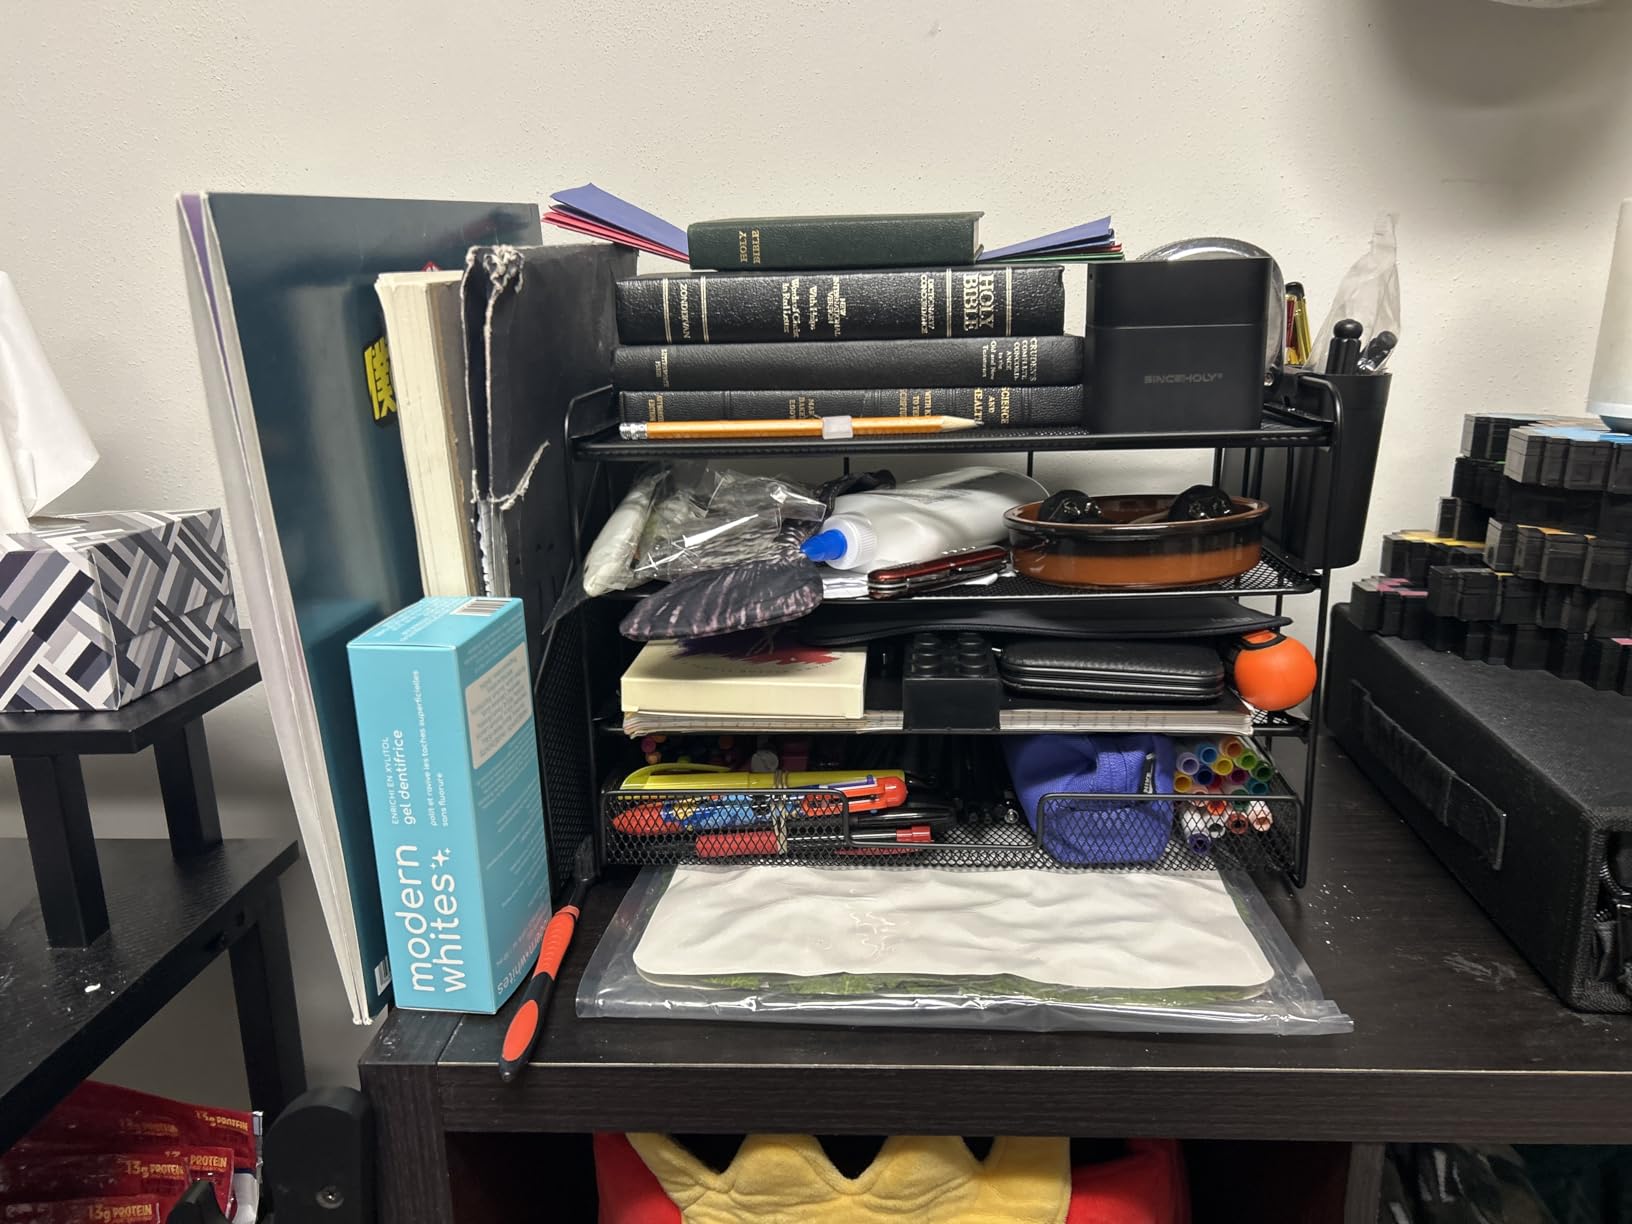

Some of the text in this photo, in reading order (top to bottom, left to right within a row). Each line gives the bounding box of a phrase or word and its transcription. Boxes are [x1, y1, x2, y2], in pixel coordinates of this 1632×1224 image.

[738, 231, 748, 263] HOLY
[751, 229, 761, 264] BIBLE
[679, 283, 691, 339] ZONDERVAN
[809, 285, 818, 307] With
[832, 275, 841, 337] INTERNATIONAL
[920, 274, 929, 334] CONCORDANCE
[963, 273, 979, 331] BIBLE
[979, 273, 995, 329] HOLY
[1029, 337, 1038, 382] CRUDEN'S
[798, 396, 806, 417] BAKE
[808, 399, 816, 417] MAR
[988, 395, 997, 413] AND
[1000, 387, 1010, 424] SCIENCE
[412, 669, 426, 727] superficielles
[419, 727, 429, 757] taches
[382, 737, 399, 825] ENRICHI EN XYLITOL
[393, 729, 416, 825] gel dentifrice
[422, 758, 431, 770] les
[424, 771, 433, 796] ravive
[436, 771, 449, 827] sans fluorure
[426, 797, 433, 806] et
[394, 845, 436, 992] modern
[429, 873, 467, 993] whites
[216, 1115, 249, 1132] PROTEIN
[126, 1159, 150, 1178] 13g
[150, 1163, 185, 1177] PROTEIN
[189, 1154, 228, 1169] PROTEIN
[87, 1203, 153, 1222] 13g PROTEIN
